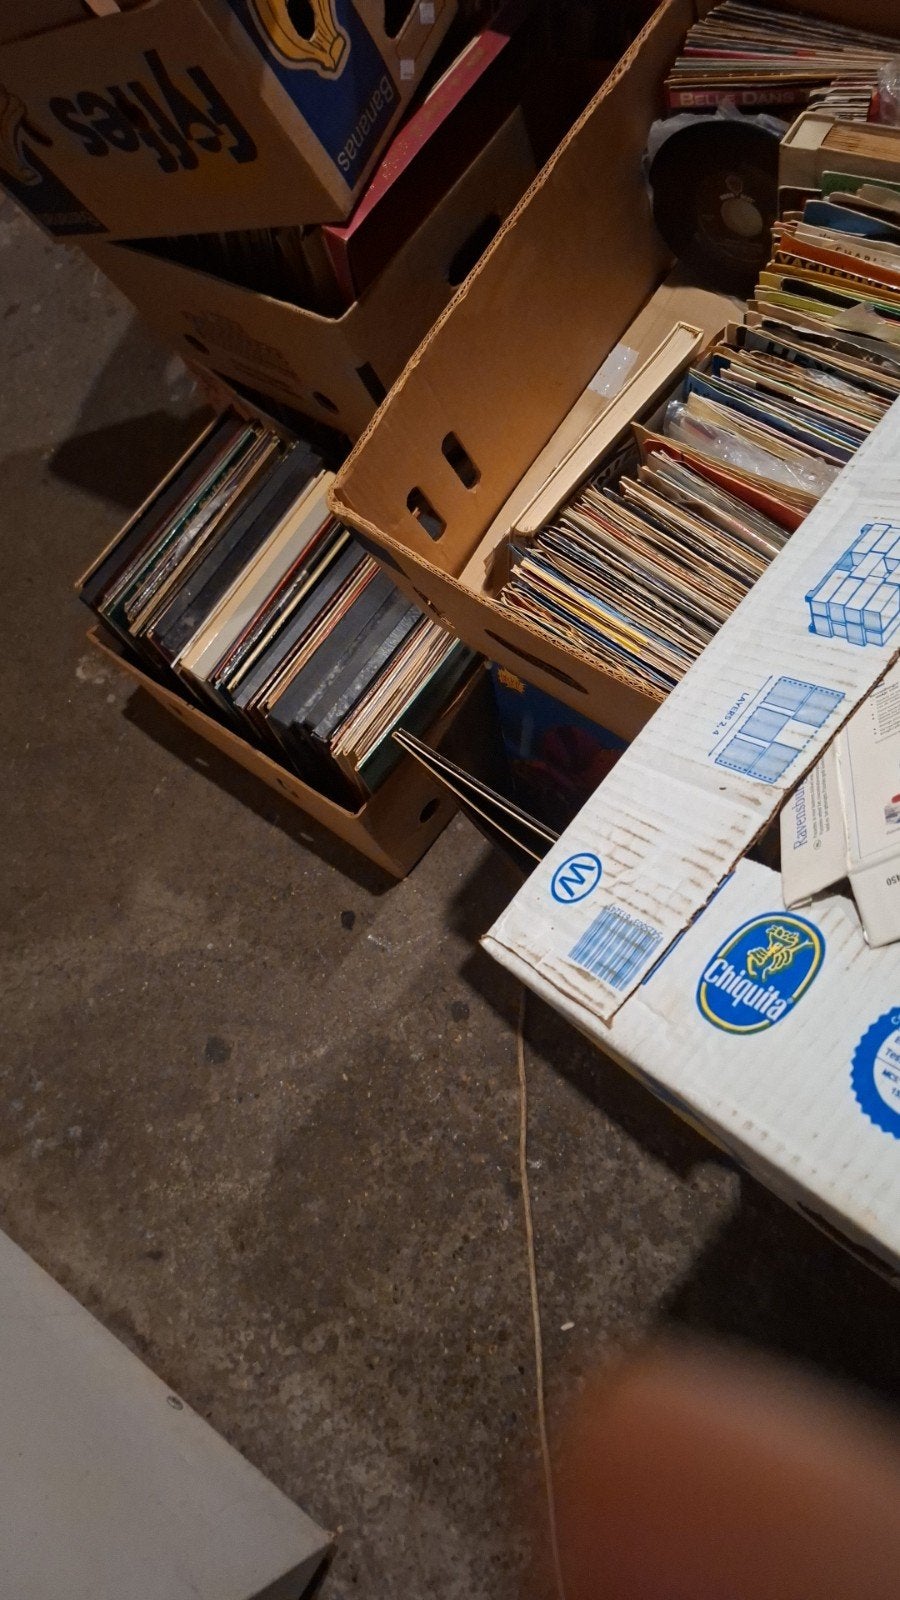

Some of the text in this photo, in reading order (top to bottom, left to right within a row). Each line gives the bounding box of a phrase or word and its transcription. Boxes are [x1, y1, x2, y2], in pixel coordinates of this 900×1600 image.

[337, 75, 392, 172] Bananas
[725, 692, 750, 720] LAYERS
[793, 778, 808, 850] Ravensbur
[704, 958, 787, 1021] Chiquita
